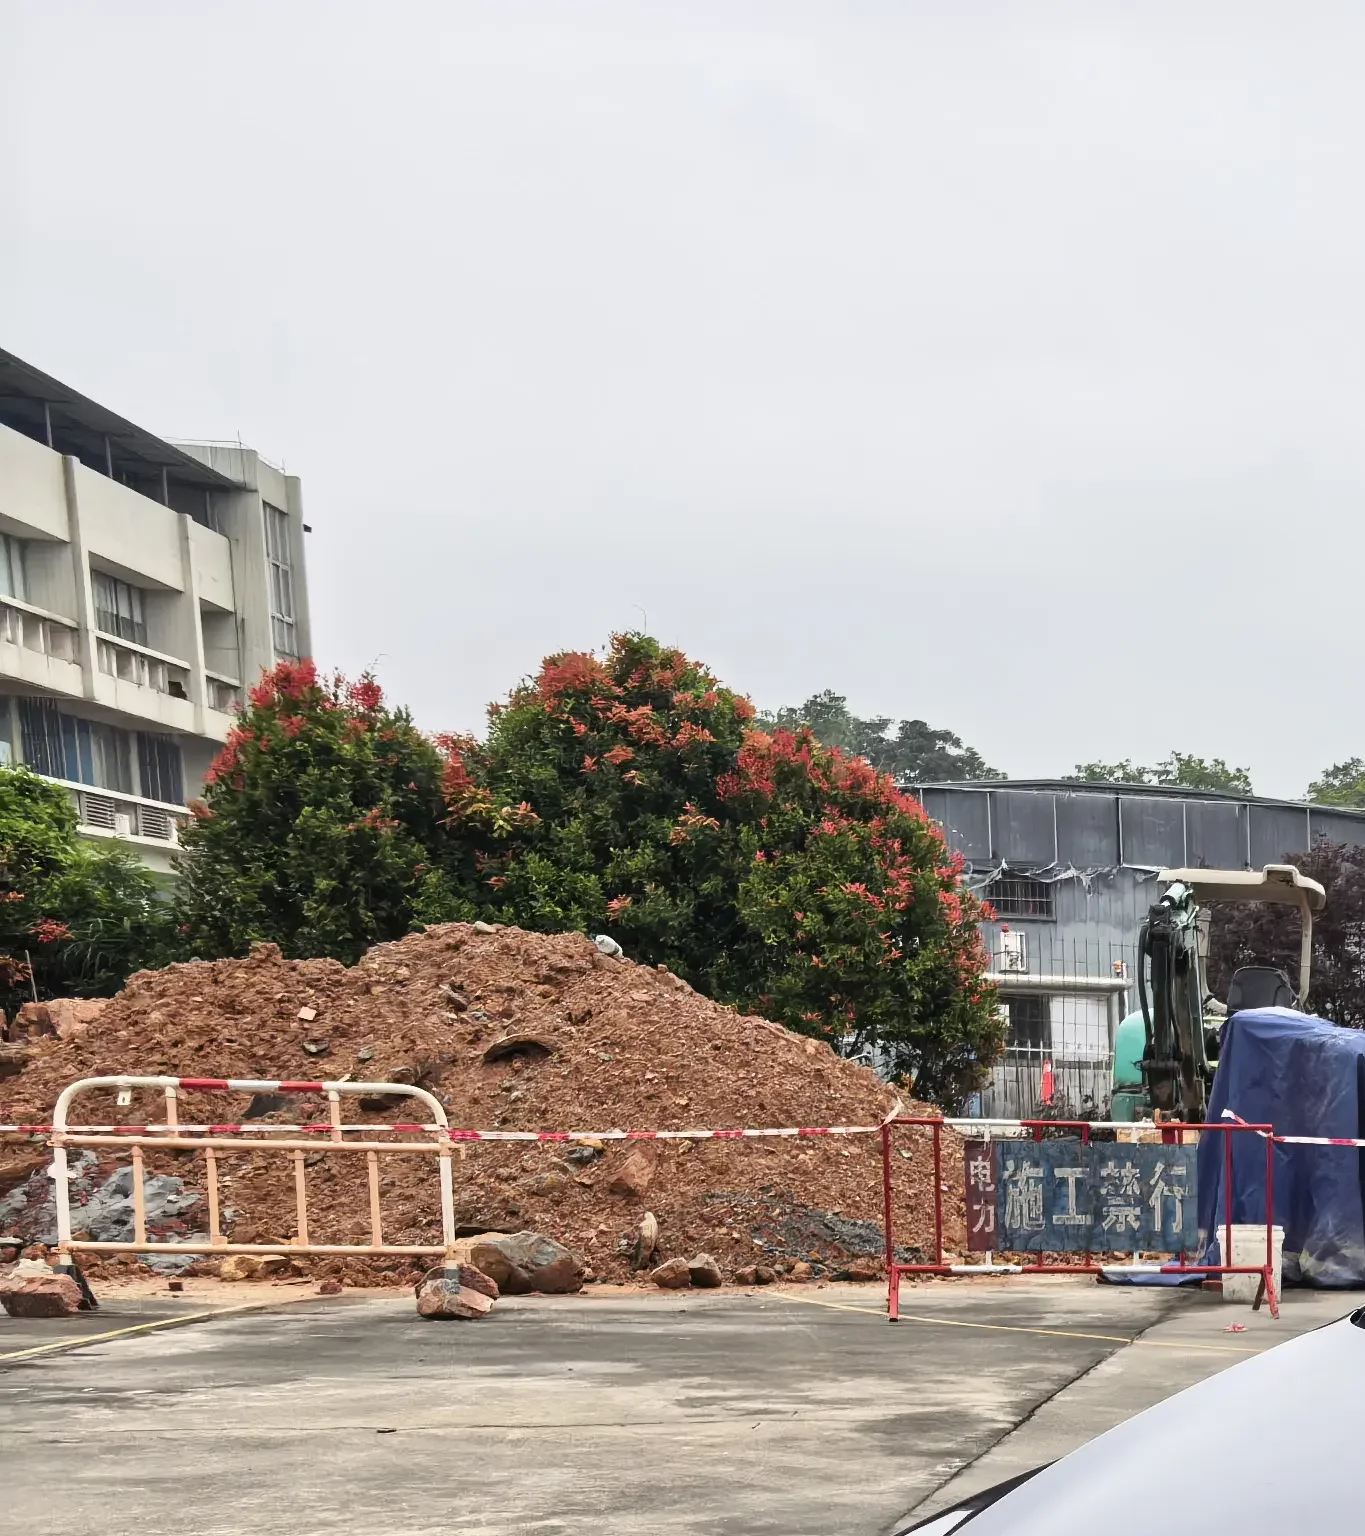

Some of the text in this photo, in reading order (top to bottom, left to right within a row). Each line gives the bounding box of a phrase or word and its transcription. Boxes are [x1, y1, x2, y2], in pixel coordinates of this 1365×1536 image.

[969, 1155, 996, 1234] 电力
[1003, 1160, 1189, 1234] 施工禁行
